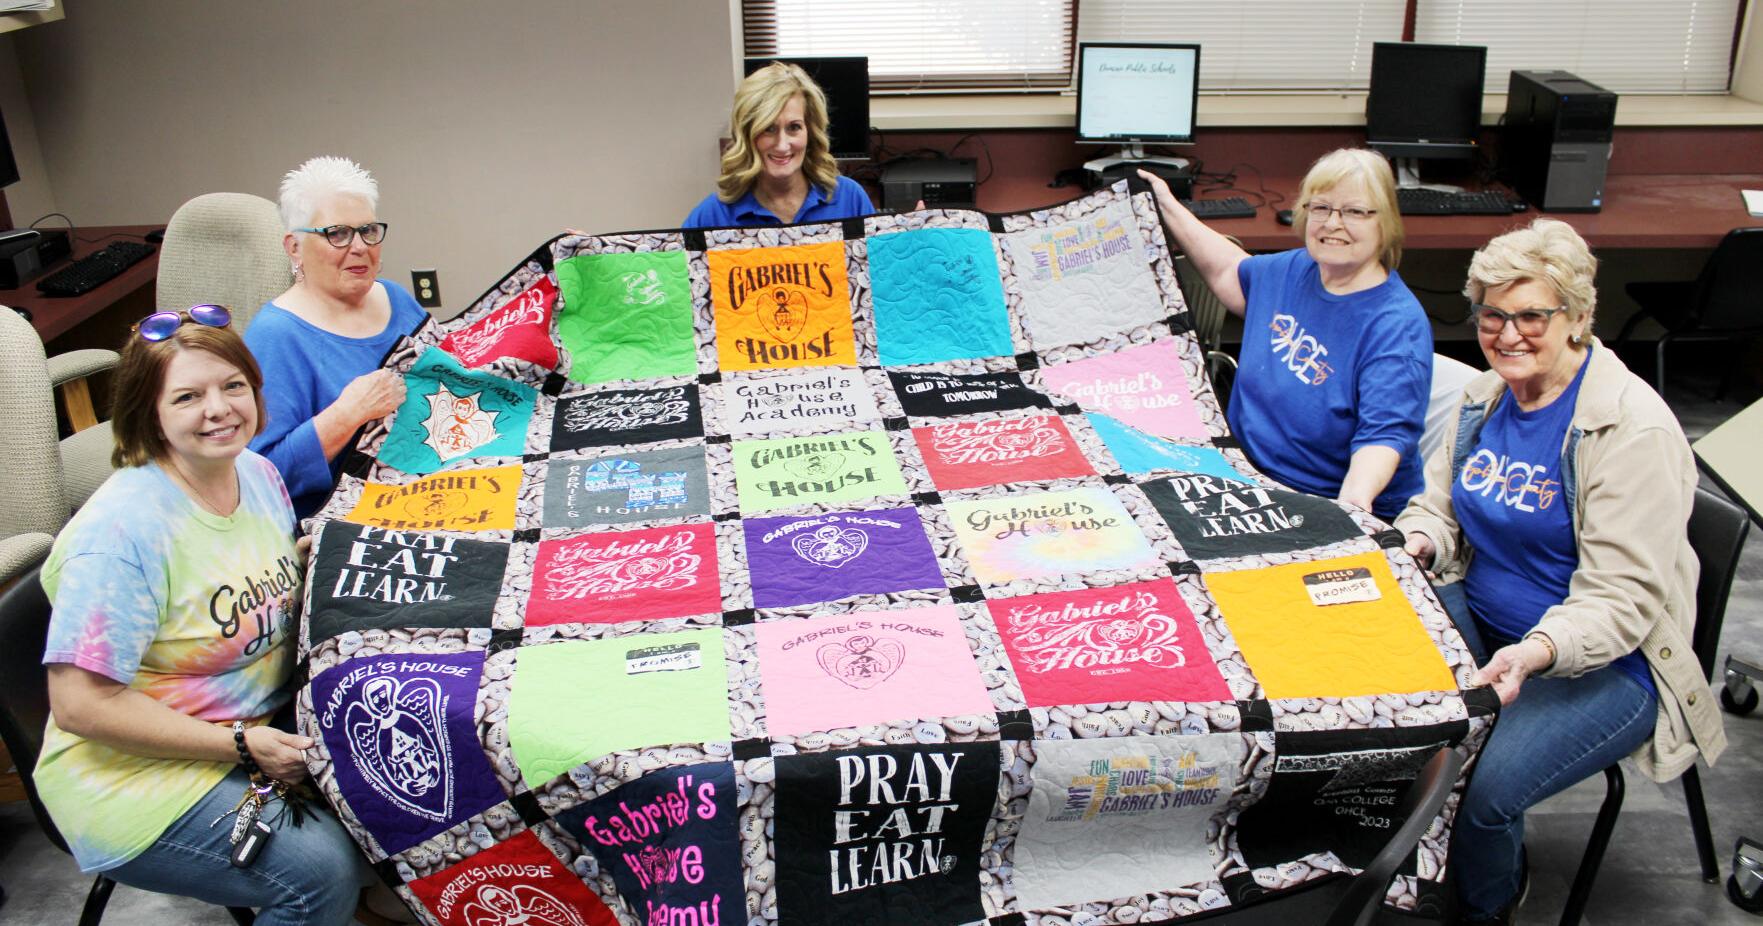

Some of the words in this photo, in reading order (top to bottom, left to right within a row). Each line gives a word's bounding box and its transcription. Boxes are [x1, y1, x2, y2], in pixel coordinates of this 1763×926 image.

[1126, 62, 1147, 73] Public
[1151, 61, 1176, 75] Schools
[1057, 245, 1101, 272] GABRIEL'S
[1101, 234, 1132, 260] HOUSE
[728, 261, 833, 310] GABRIEL'S
[735, 327, 838, 364] HOUSE
[736, 376, 851, 398] Gabriel's
[905, 380, 934, 394] CHILD
[942, 389, 998, 403] TOMORROW
[1062, 371, 1162, 398] Gabriel's
[739, 403, 857, 423] Academy
[751, 437, 876, 469] GABRIEL'S
[374, 475, 502, 509] GABRIEL'S
[567, 465, 581, 518] GABRIEL'S
[756, 467, 881, 497] HOUSE
[1168, 475, 1247, 501] PRA
[1461, 448, 1547, 513] OHCE
[596, 502, 686, 515] HOUSE
[1180, 487, 1277, 518] EAT
[762, 516, 841, 544] GABRIEL'S
[846, 516, 901, 528] HOUSE
[966, 502, 1094, 531] Gabriel's
[1198, 506, 1292, 538] LEARN
[347, 540, 459, 578] EAT
[332, 568, 448, 604] LEARN
[1318, 570, 1354, 580] HELLO
[1315, 581, 1368, 600] PROMISE
[1008, 591, 1160, 632] Gabriel's
[781, 621, 873, 651] GABRIEL'S
[880, 622, 945, 639] HOUSE
[1018, 646, 1186, 674] House
[322, 661, 396, 729] GABRIEL'S
[400, 661, 473, 678] HOUSE
[891, 732, 911, 741] Faith
[920, 727, 938, 739] Love
[1082, 722, 1099, 732] Faith
[836, 752, 964, 805] PRAY
[1090, 759, 1109, 777] FUN
[1121, 769, 1149, 787] LOVE
[584, 775, 717, 847] Gabriel's
[1099, 792, 1173, 813] GABRIEL'S
[1173, 788, 1220, 807] HOUSE
[1342, 795, 1396, 806] COLLEGE
[475, 831, 489, 839] Love
[747, 814, 756, 832] Faith
[833, 804, 959, 844] EAT
[1359, 816, 1390, 829] 2023
[746, 839, 762, 859] Peace
[755, 874, 768, 884] God
[829, 838, 946, 895] LEARN
[437, 867, 487, 920] GABRIEL'S
[483, 864, 554, 879] HOUSE
[1205, 896, 1220, 907] Love
